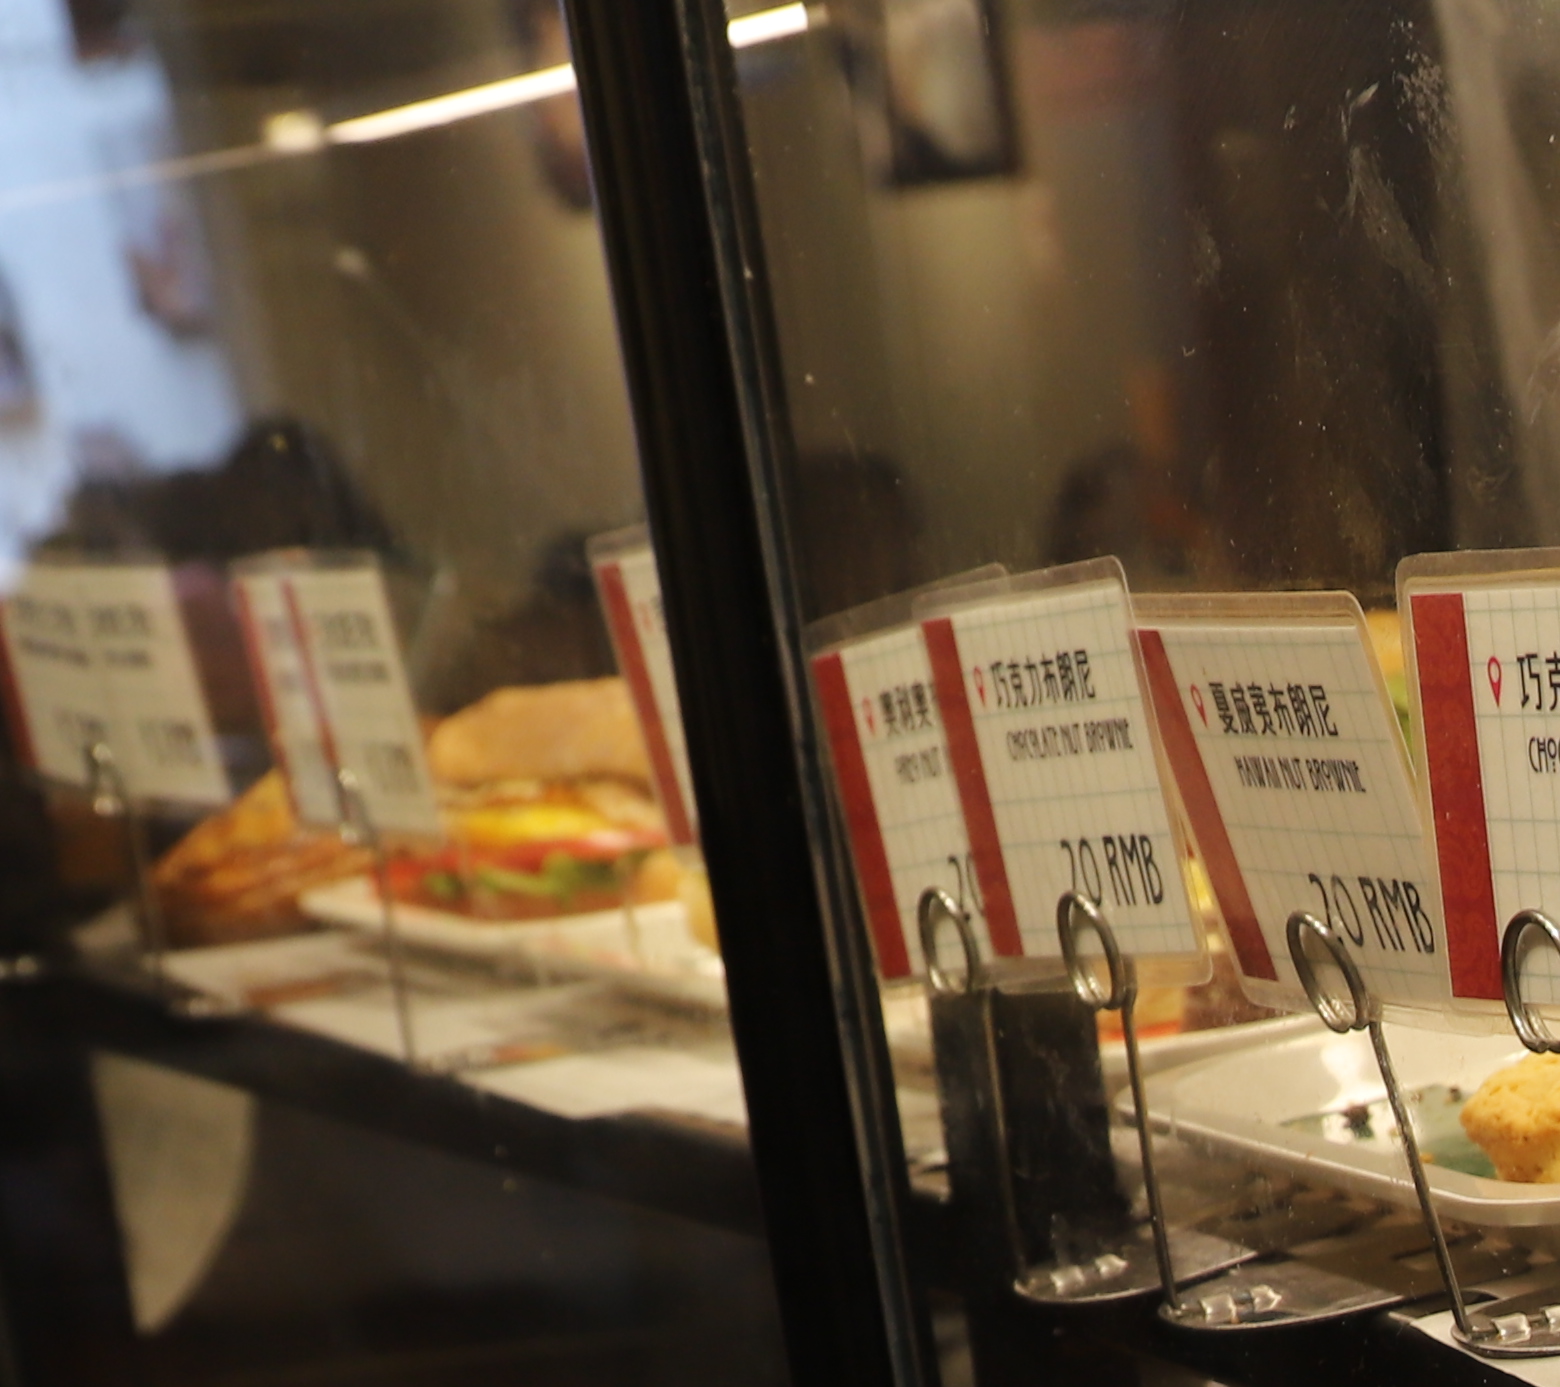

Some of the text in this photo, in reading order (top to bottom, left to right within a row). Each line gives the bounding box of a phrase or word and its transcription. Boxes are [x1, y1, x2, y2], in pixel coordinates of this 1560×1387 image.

[990, 649, 1097, 709] 巧克力布朗尼
[879, 682, 937, 738] 奥利奥
[1208, 681, 1339, 739] 夏威夷布朗尼
[1305, 757, 1367, 794] BROWNIE
[1102, 833, 1164, 907] RMB
[1309, 872, 1436, 955] 20 RMB
